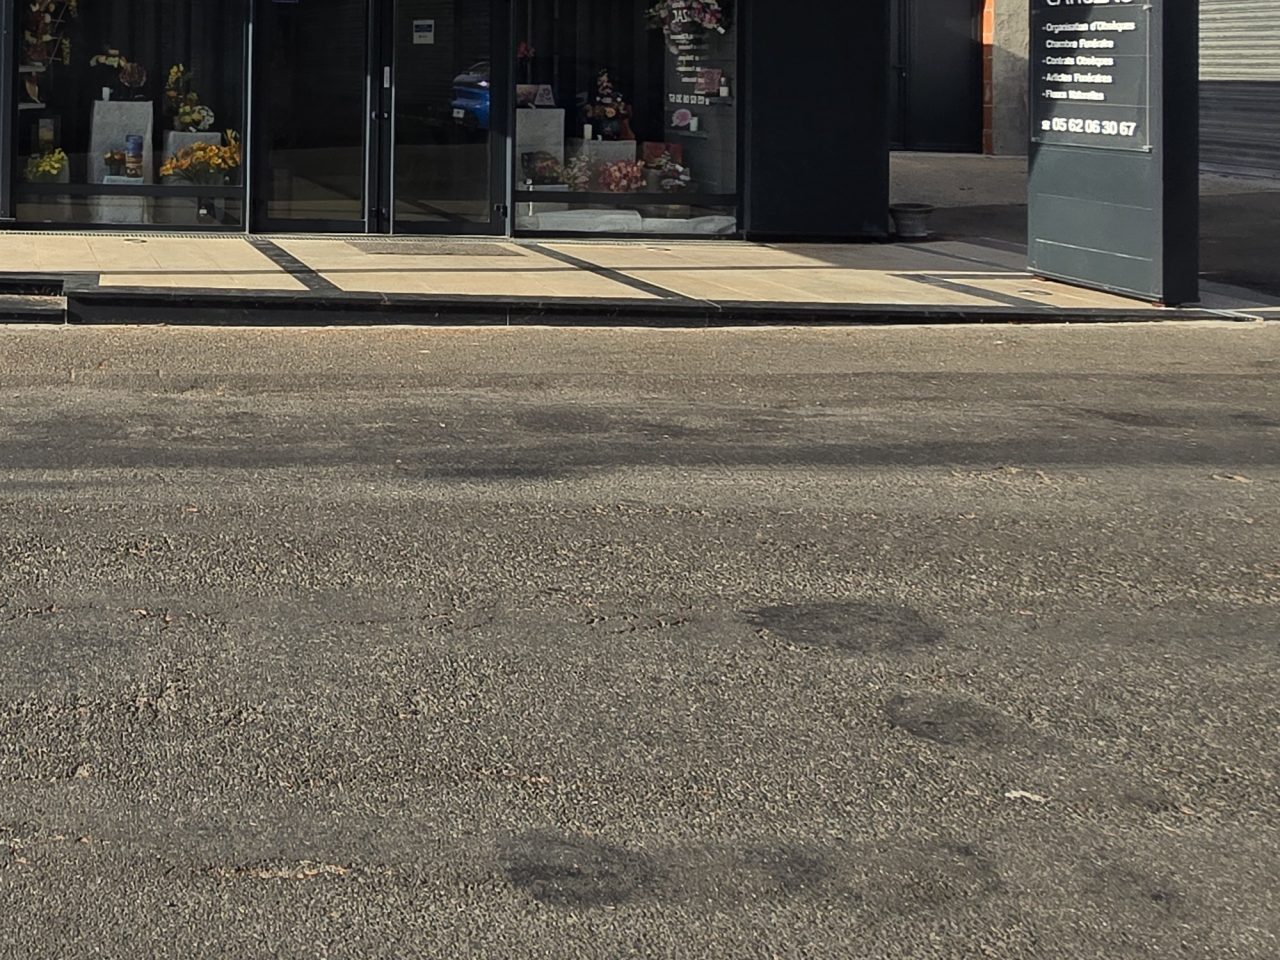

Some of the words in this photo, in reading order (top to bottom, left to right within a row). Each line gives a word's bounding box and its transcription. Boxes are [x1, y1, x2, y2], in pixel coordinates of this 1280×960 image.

[1052, 117, 1067, 131] 05
[1068, 118, 1083, 132] 62
[1085, 119, 1100, 133] 06
[1101, 120, 1118, 135] 30
[1119, 121, 1136, 136] 67
